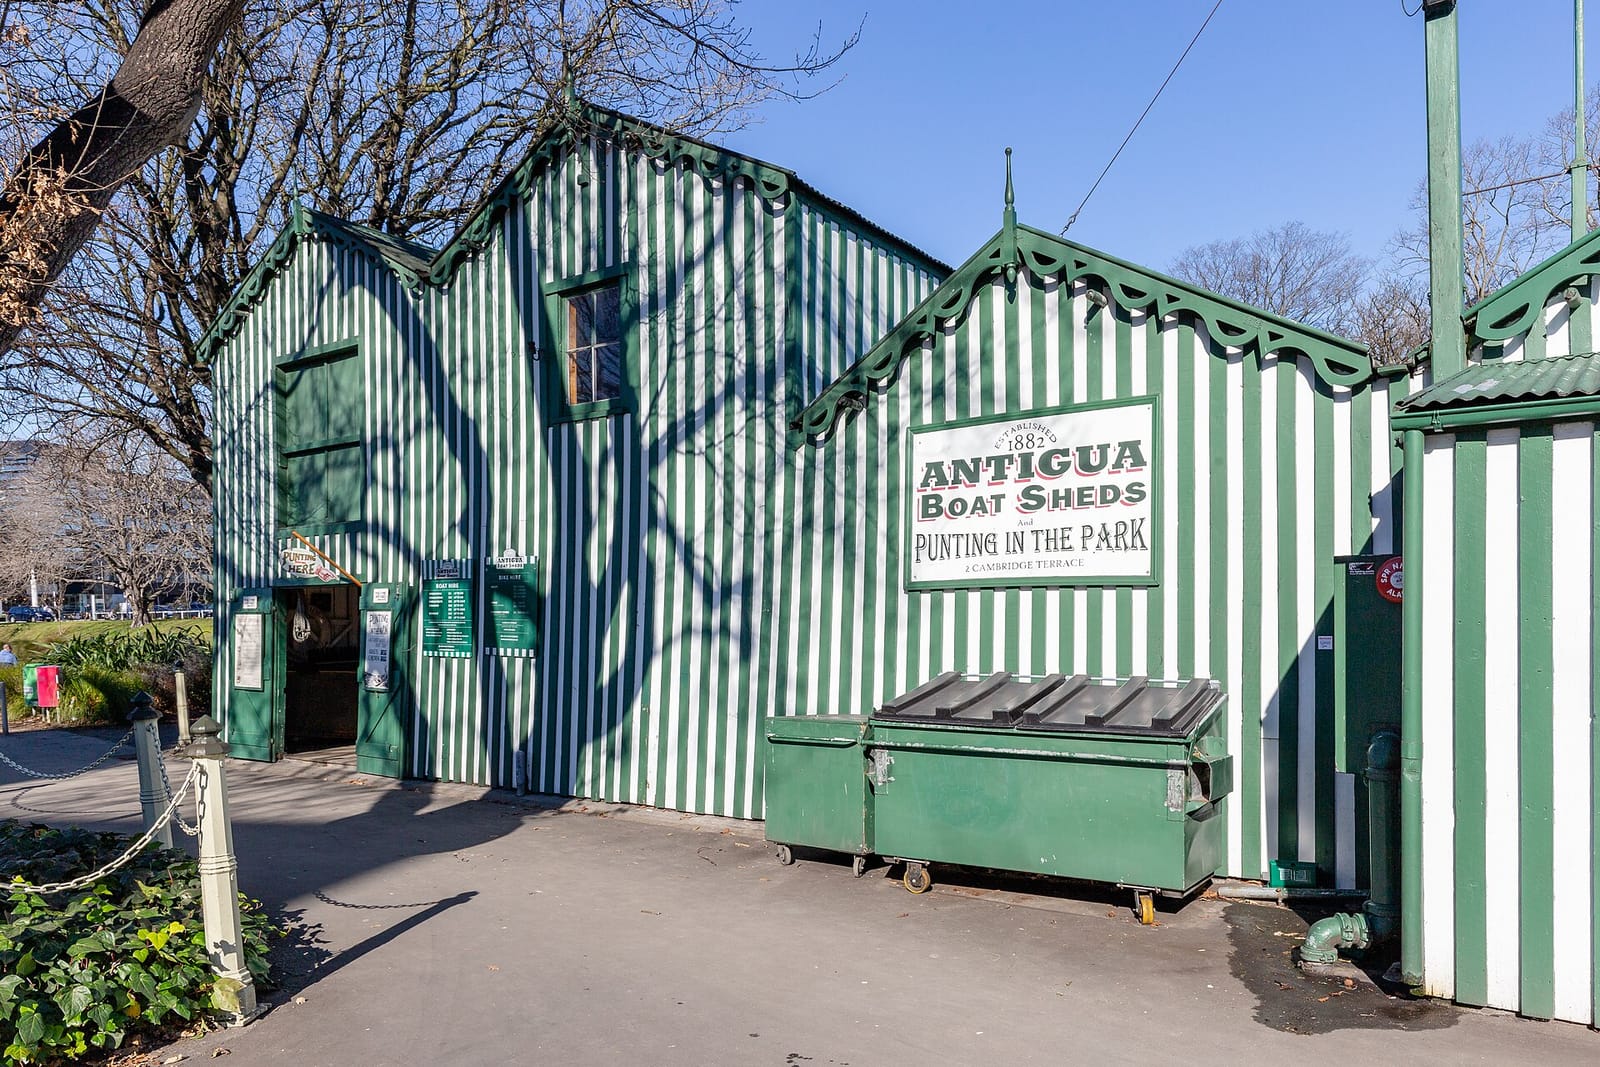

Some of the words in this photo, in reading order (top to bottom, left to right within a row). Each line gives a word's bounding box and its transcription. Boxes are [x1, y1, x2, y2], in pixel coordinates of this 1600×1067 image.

[994, 422, 1057, 449] ESTABLISHED
[1008, 433, 1045, 451] 1882
[918, 440, 1147, 491] ANTIGUA
[1017, 518, 1034, 527] And
[915, 532, 999, 563] PUNTING
[1005, 530, 1024, 555] IN
[1031, 526, 1073, 554] THE
[1081, 517, 1148, 553] PARK
[283, 552, 316, 562] PUNTING
[288, 563, 316, 575] HERE
[965, 565, 970, 573] 2
[971, 561, 1033, 573] CAMBRIDGE
[1035, 558, 1085, 570] TERRACE
[1380, 568, 1391, 583] SPR
[1386, 588, 1403, 598] ALA
